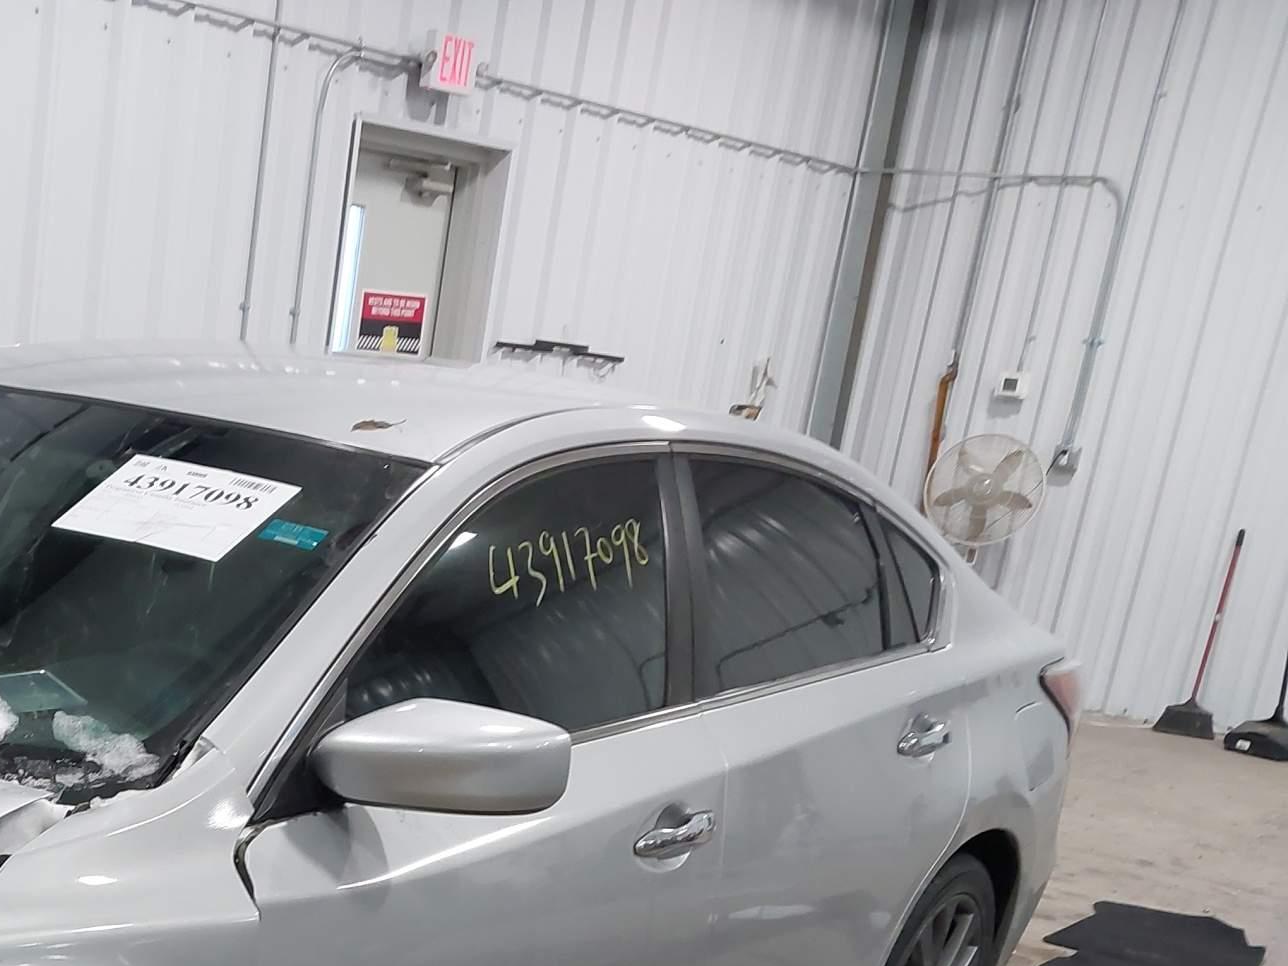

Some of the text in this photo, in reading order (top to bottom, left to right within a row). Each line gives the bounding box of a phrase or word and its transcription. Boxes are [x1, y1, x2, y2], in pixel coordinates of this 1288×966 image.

[440, 36, 473, 87] EXIT
[123, 474, 260, 510] 43917098
[489, 518, 649, 607] 43917098
